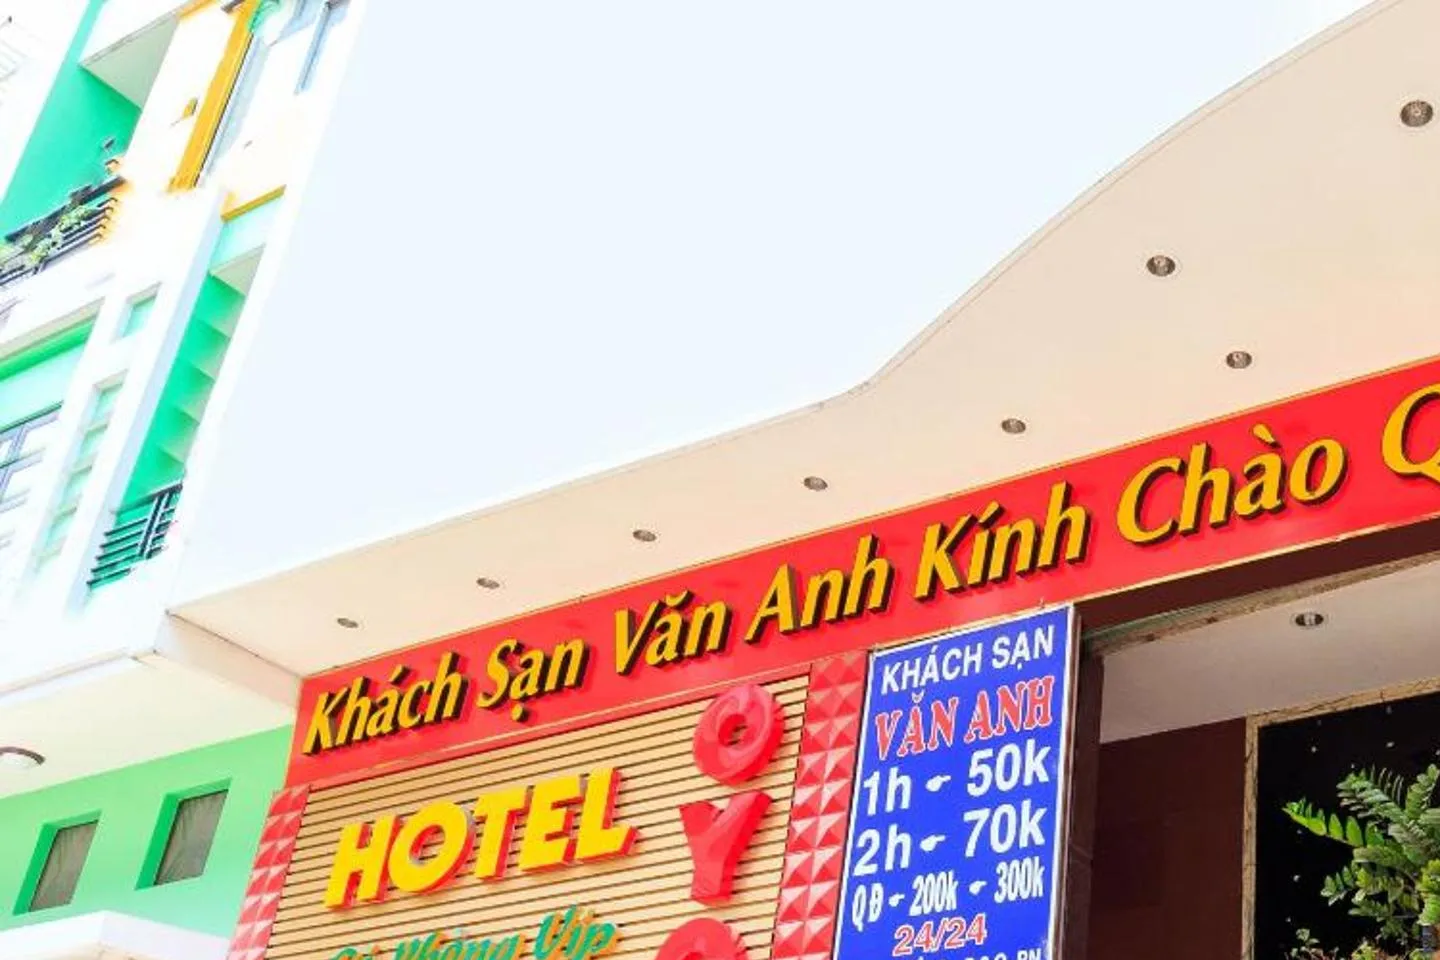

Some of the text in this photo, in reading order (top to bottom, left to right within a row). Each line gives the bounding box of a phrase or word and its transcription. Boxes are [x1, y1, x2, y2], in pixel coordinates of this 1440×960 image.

[303, 653, 464, 754] Khách
[477, 638, 586, 719] Sạn
[613, 590, 729, 673] Văn
[747, 537, 890, 641] Anh
[916, 484, 1088, 598] Kính
[1117, 425, 1346, 543] Chào
[880, 624, 1055, 695] KHÁCH SẠN
[874, 675, 1056, 761] VĂN ANH
[863, 738, 1051, 817] 1h 50k
[325, 766, 634, 908] HOTEL
[852, 798, 1048, 878] 2h 70k
[908, 869, 960, 917] 200k
[993, 855, 1046, 904] 300k
[891, 912, 988, 958] 24/24
